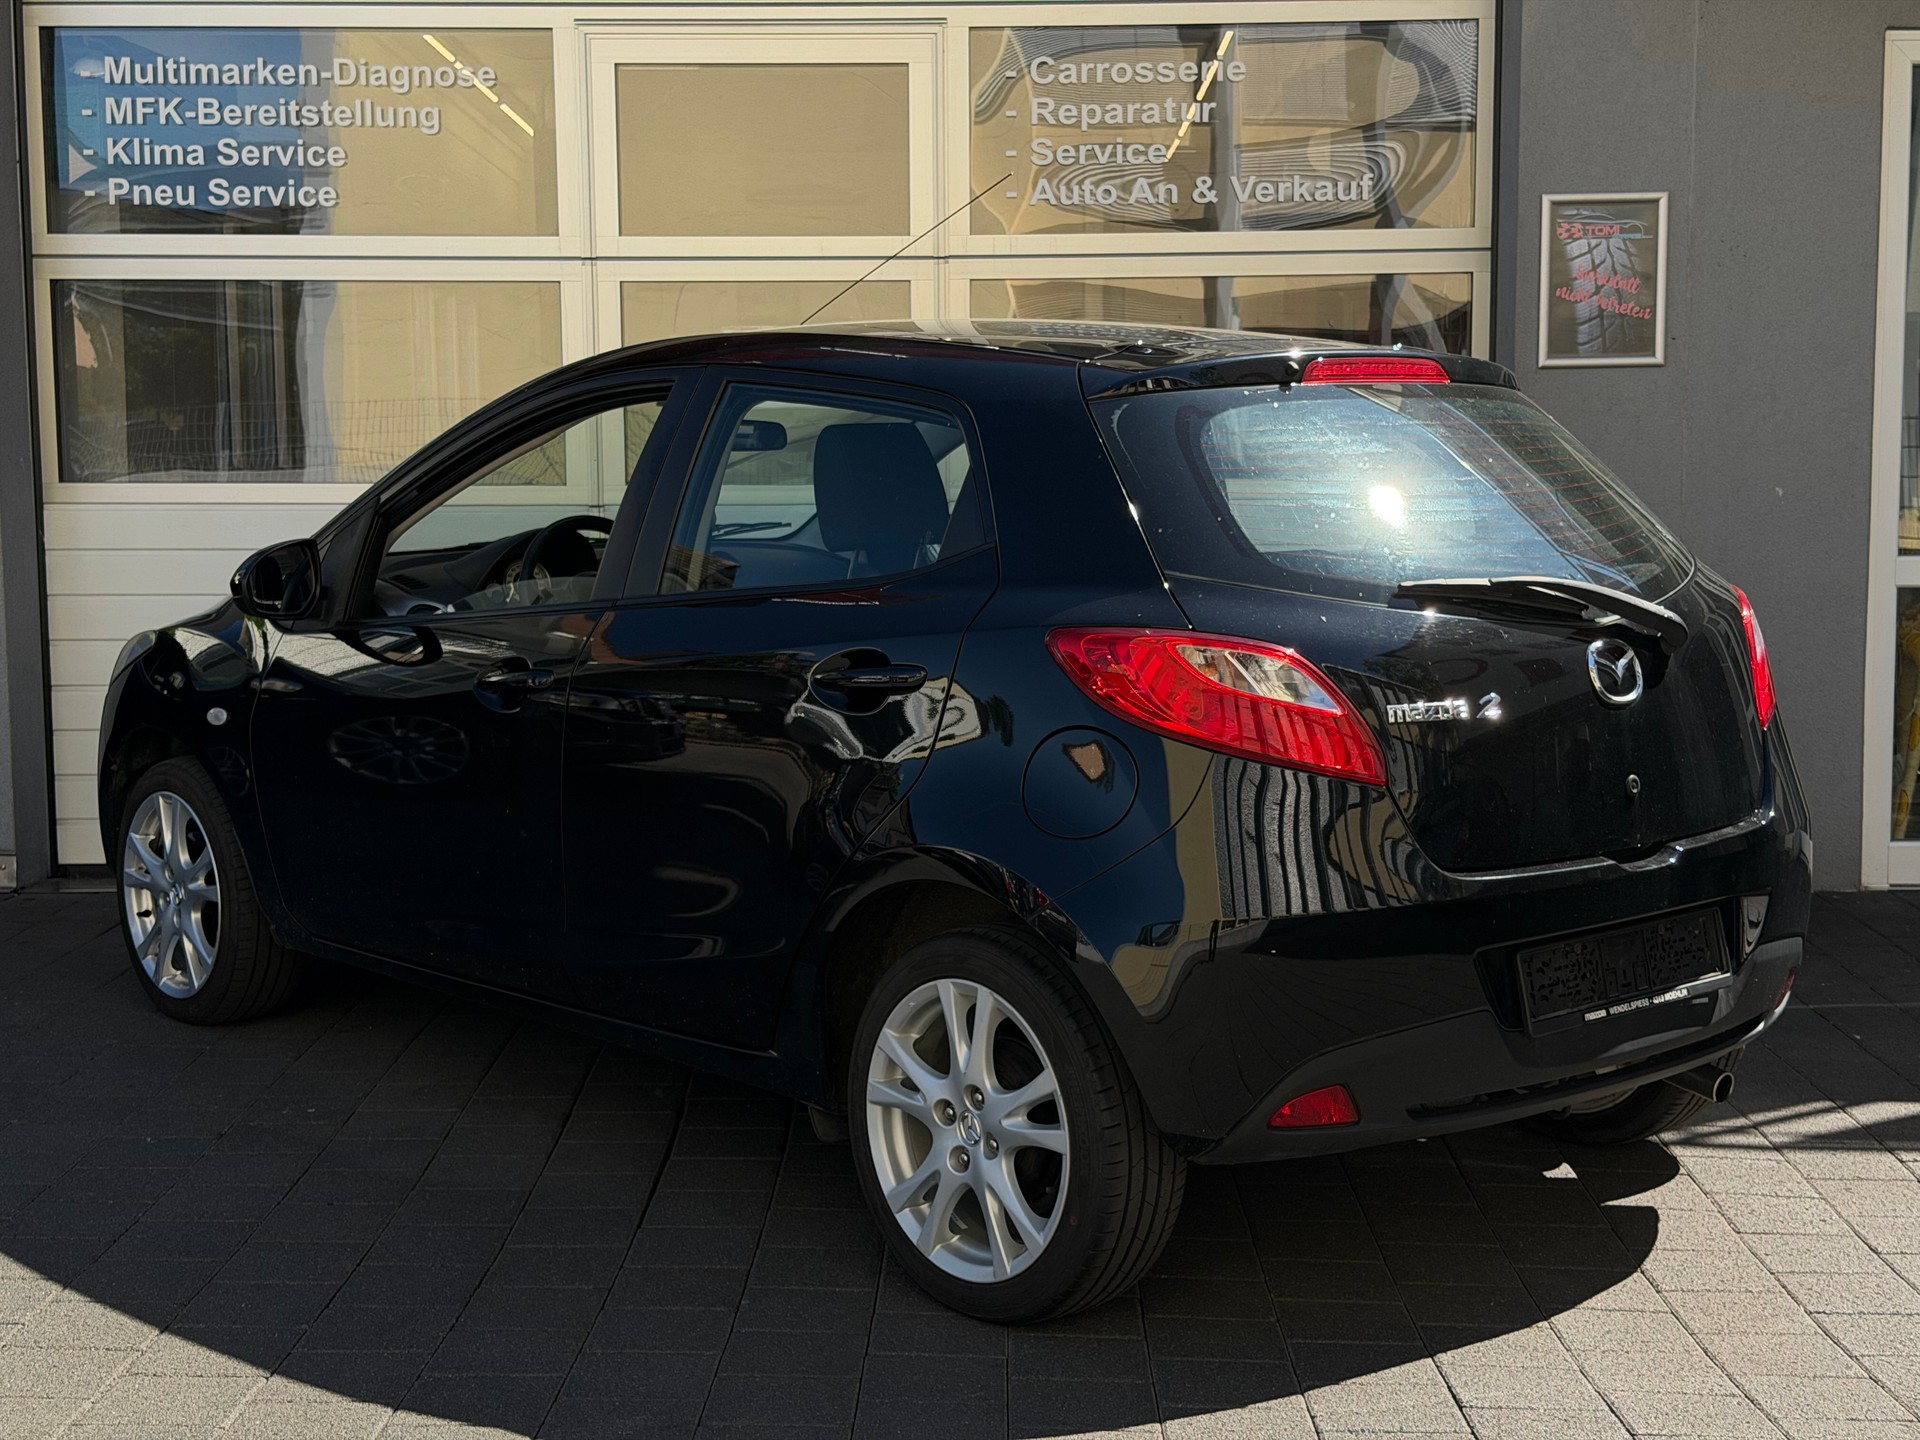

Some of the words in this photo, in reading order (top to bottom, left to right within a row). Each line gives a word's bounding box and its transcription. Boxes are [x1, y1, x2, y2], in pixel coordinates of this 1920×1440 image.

[103, 56, 497, 93] Multimarken-Diagnose
[1029, 55, 1246, 85] Carrosserie
[104, 97, 441, 135] MFK-Bereitstellung
[1030, 97, 1217, 131] Reparatur
[106, 137, 205, 167] Klima
[216, 138, 348, 168] Service
[1029, 137, 1168, 166] Service
[107, 178, 196, 207] Pneu
[207, 178, 339, 208] Service
[1029, 177, 1117, 206] Auto
[1128, 176, 1179, 204] An
[1192, 176, 1219, 204] &
[1230, 173, 1374, 203] Verkauf
[1476, 692, 1502, 719] 2
